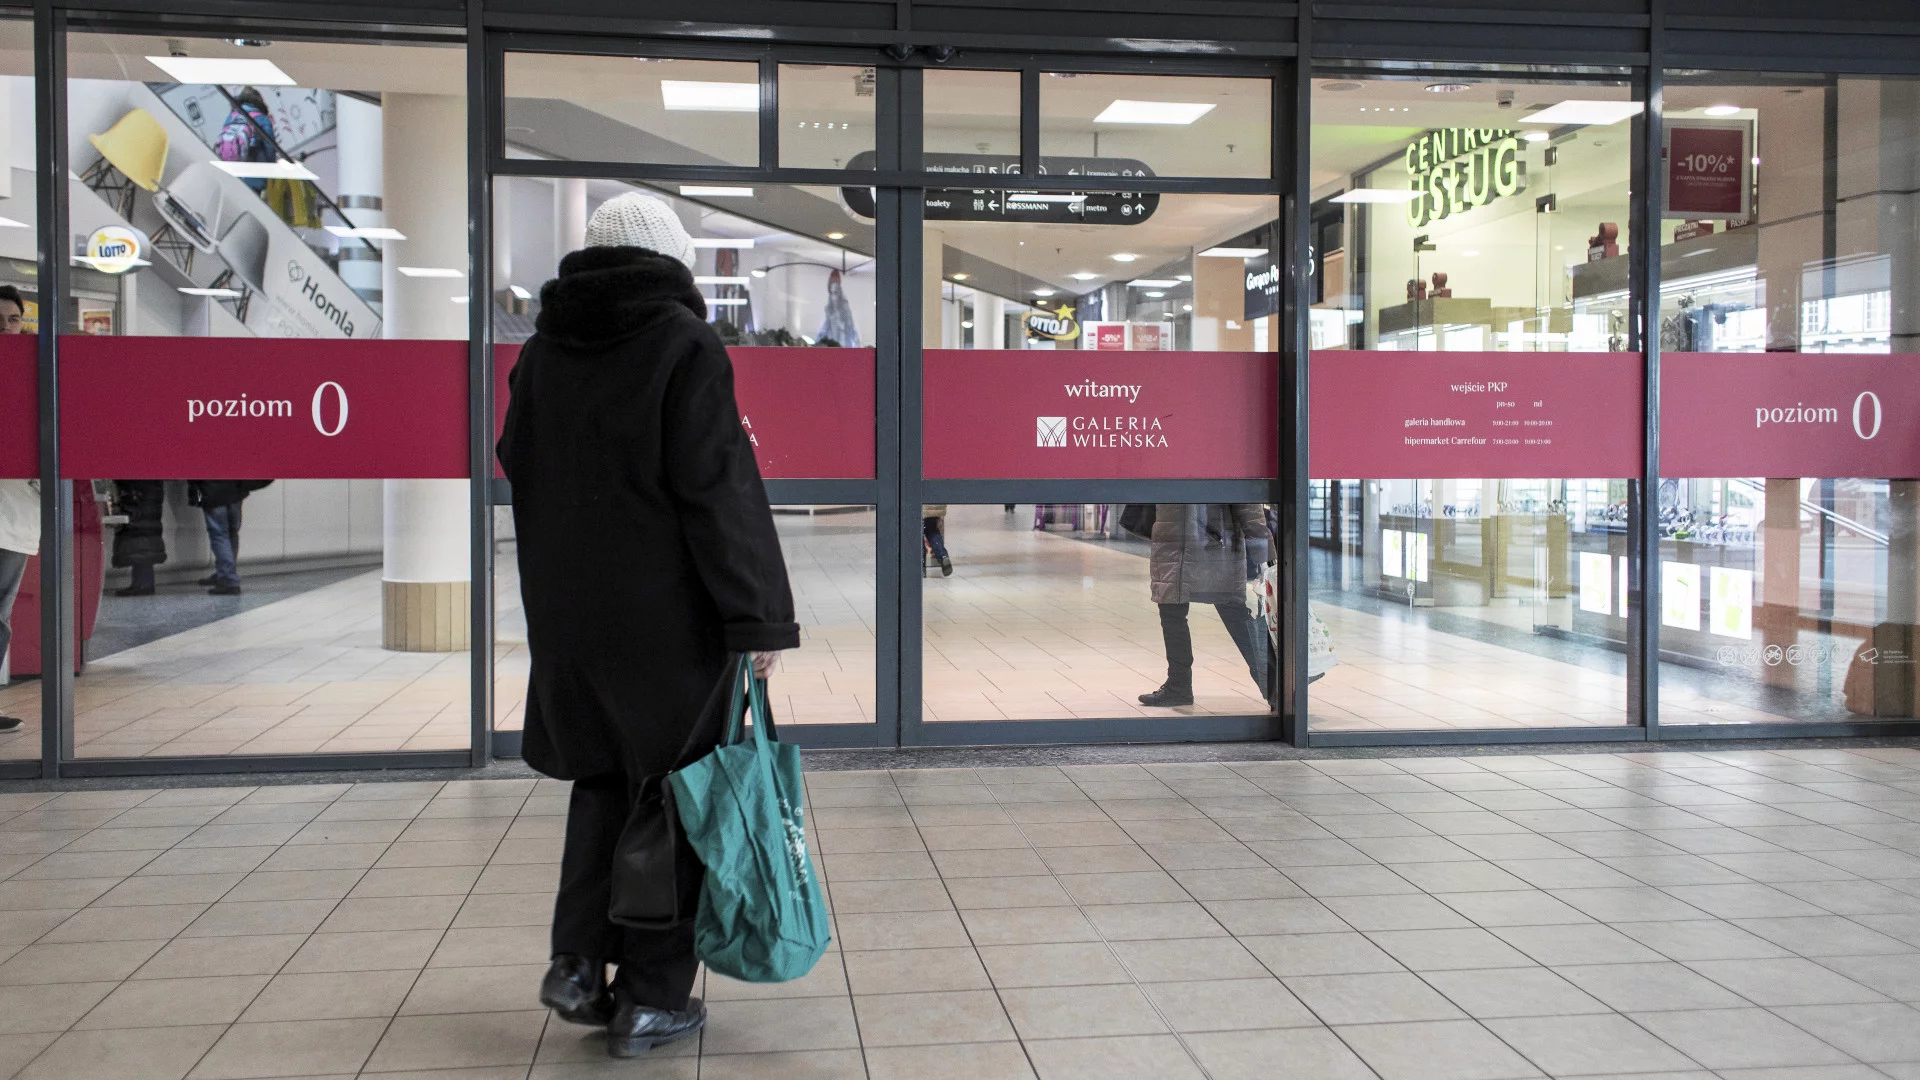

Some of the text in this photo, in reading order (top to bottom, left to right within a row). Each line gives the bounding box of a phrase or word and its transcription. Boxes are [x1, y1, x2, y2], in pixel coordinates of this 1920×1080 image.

[1406, 138, 1518, 229] USŁUG
[926, 199, 951, 209] toalety
[1006, 202, 1049, 210] ROSSMANN
[1086, 204, 1108, 212] metro
[99, 243, 126, 258] LOTTO
[302, 275, 355, 338] Homla
[1064, 378, 1142, 404] witamy
[1450, 382, 1508, 394] wejście PKP
[187, 380, 349, 437] poziom 0
[1496, 399, 1543, 410] pn-so nd
[1404, 418, 1428, 428] galeria
[1430, 417, 1466, 426] handlowa
[1755, 391, 1882, 440] poziom 0
[1072, 416, 1162, 431] GALERIA
[1072, 431, 1169, 448] WILEŃSKA
[1404, 436, 1449, 447] hipermarket
[1451, 436, 1487, 445] Carrefour
